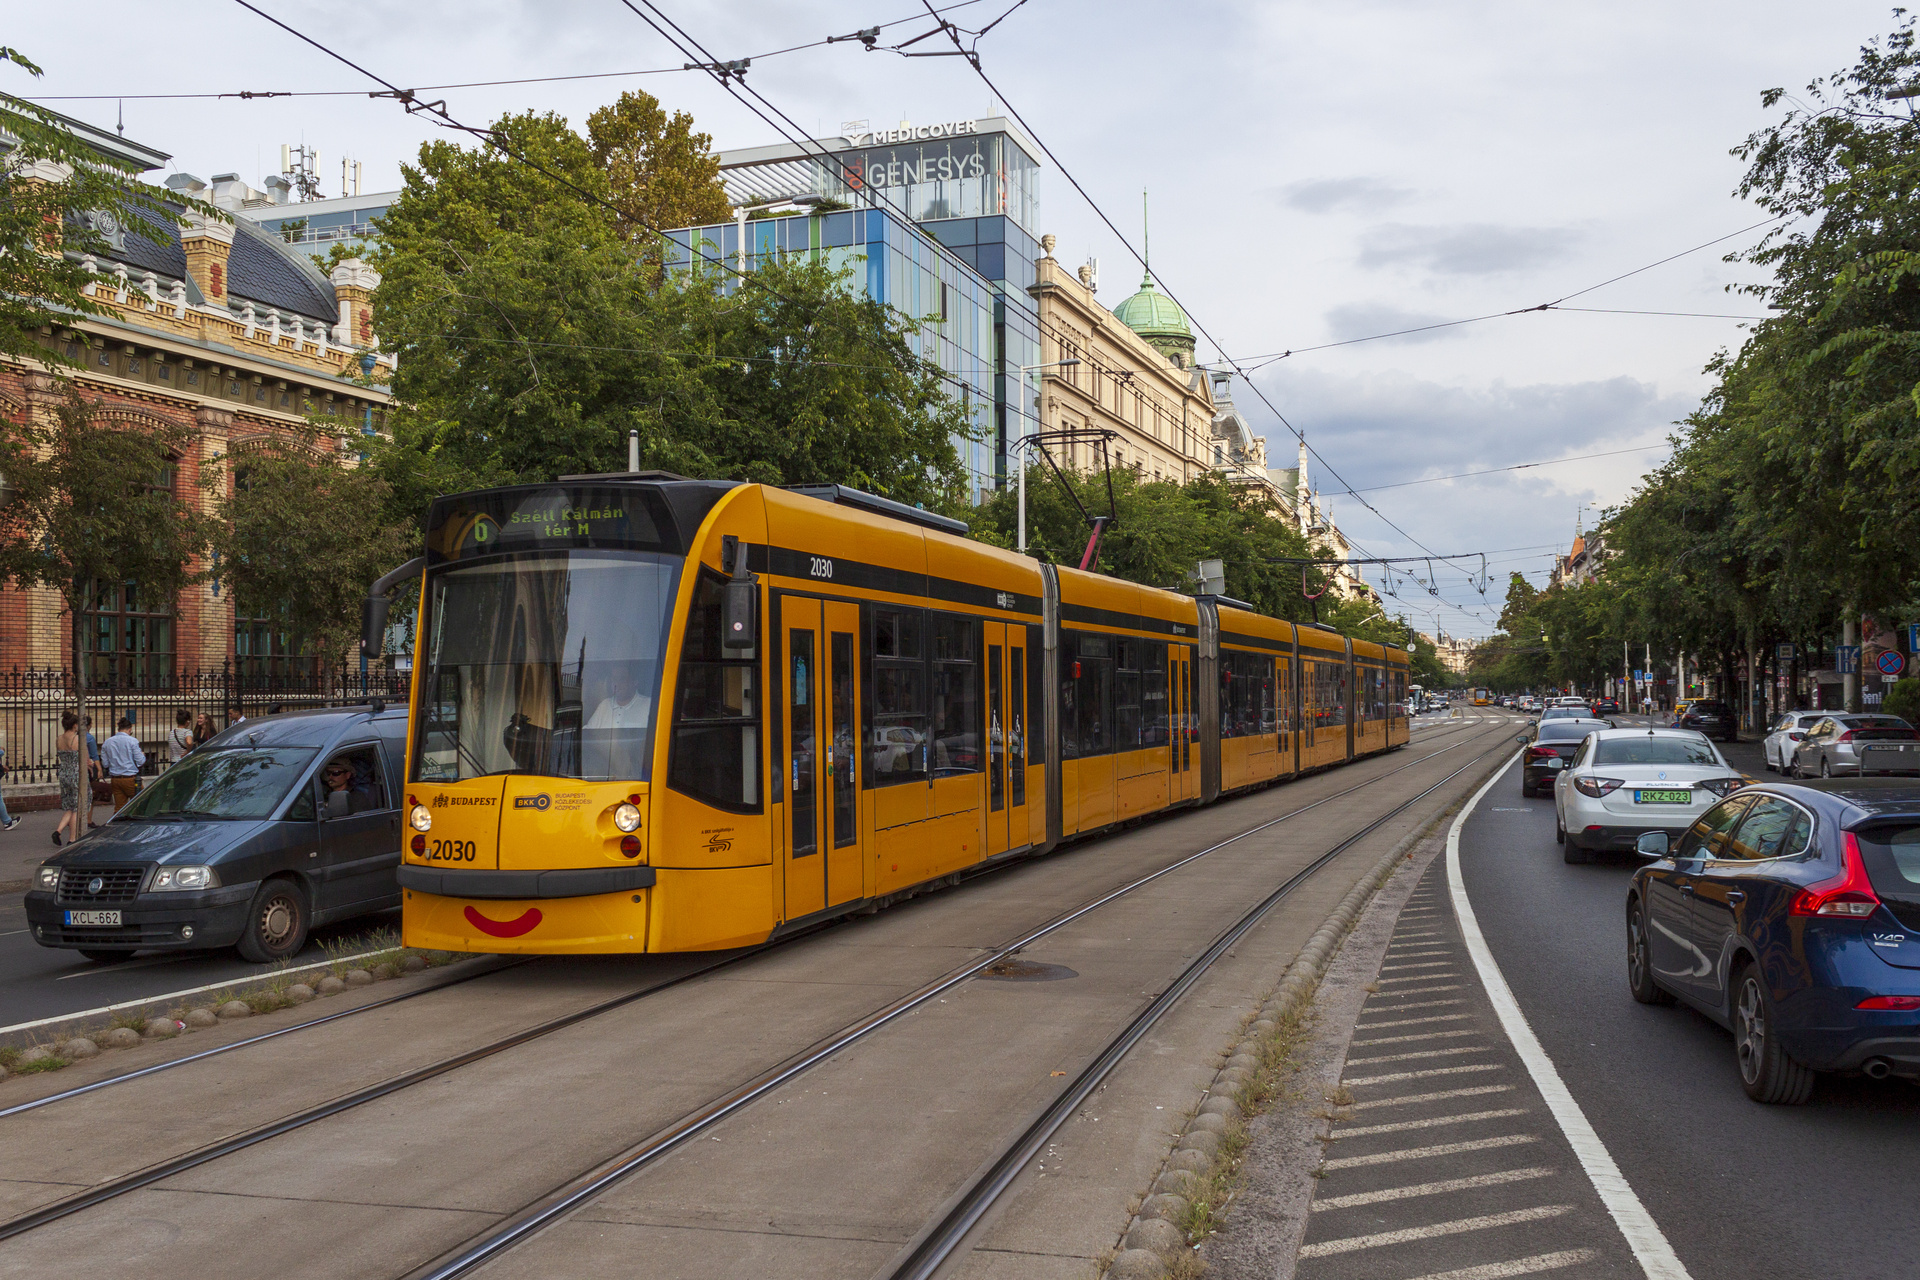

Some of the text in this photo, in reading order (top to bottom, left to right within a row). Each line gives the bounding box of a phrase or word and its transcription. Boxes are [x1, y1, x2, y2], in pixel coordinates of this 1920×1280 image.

[872, 119, 978, 145] MEDICOVER
[868, 153, 986, 189] GENESYS
[510, 505, 623, 524] Széll Kálmán
[545, 523, 589, 537] tér M
[810, 557, 833, 579] 2030
[450, 797, 498, 806] BUDAPEST
[1642, 791, 1689, 801] RKZ-023
[432, 839, 476, 862] 2030
[72, 912, 119, 924] KCL-662
[1872, 933, 1905, 942] V40
